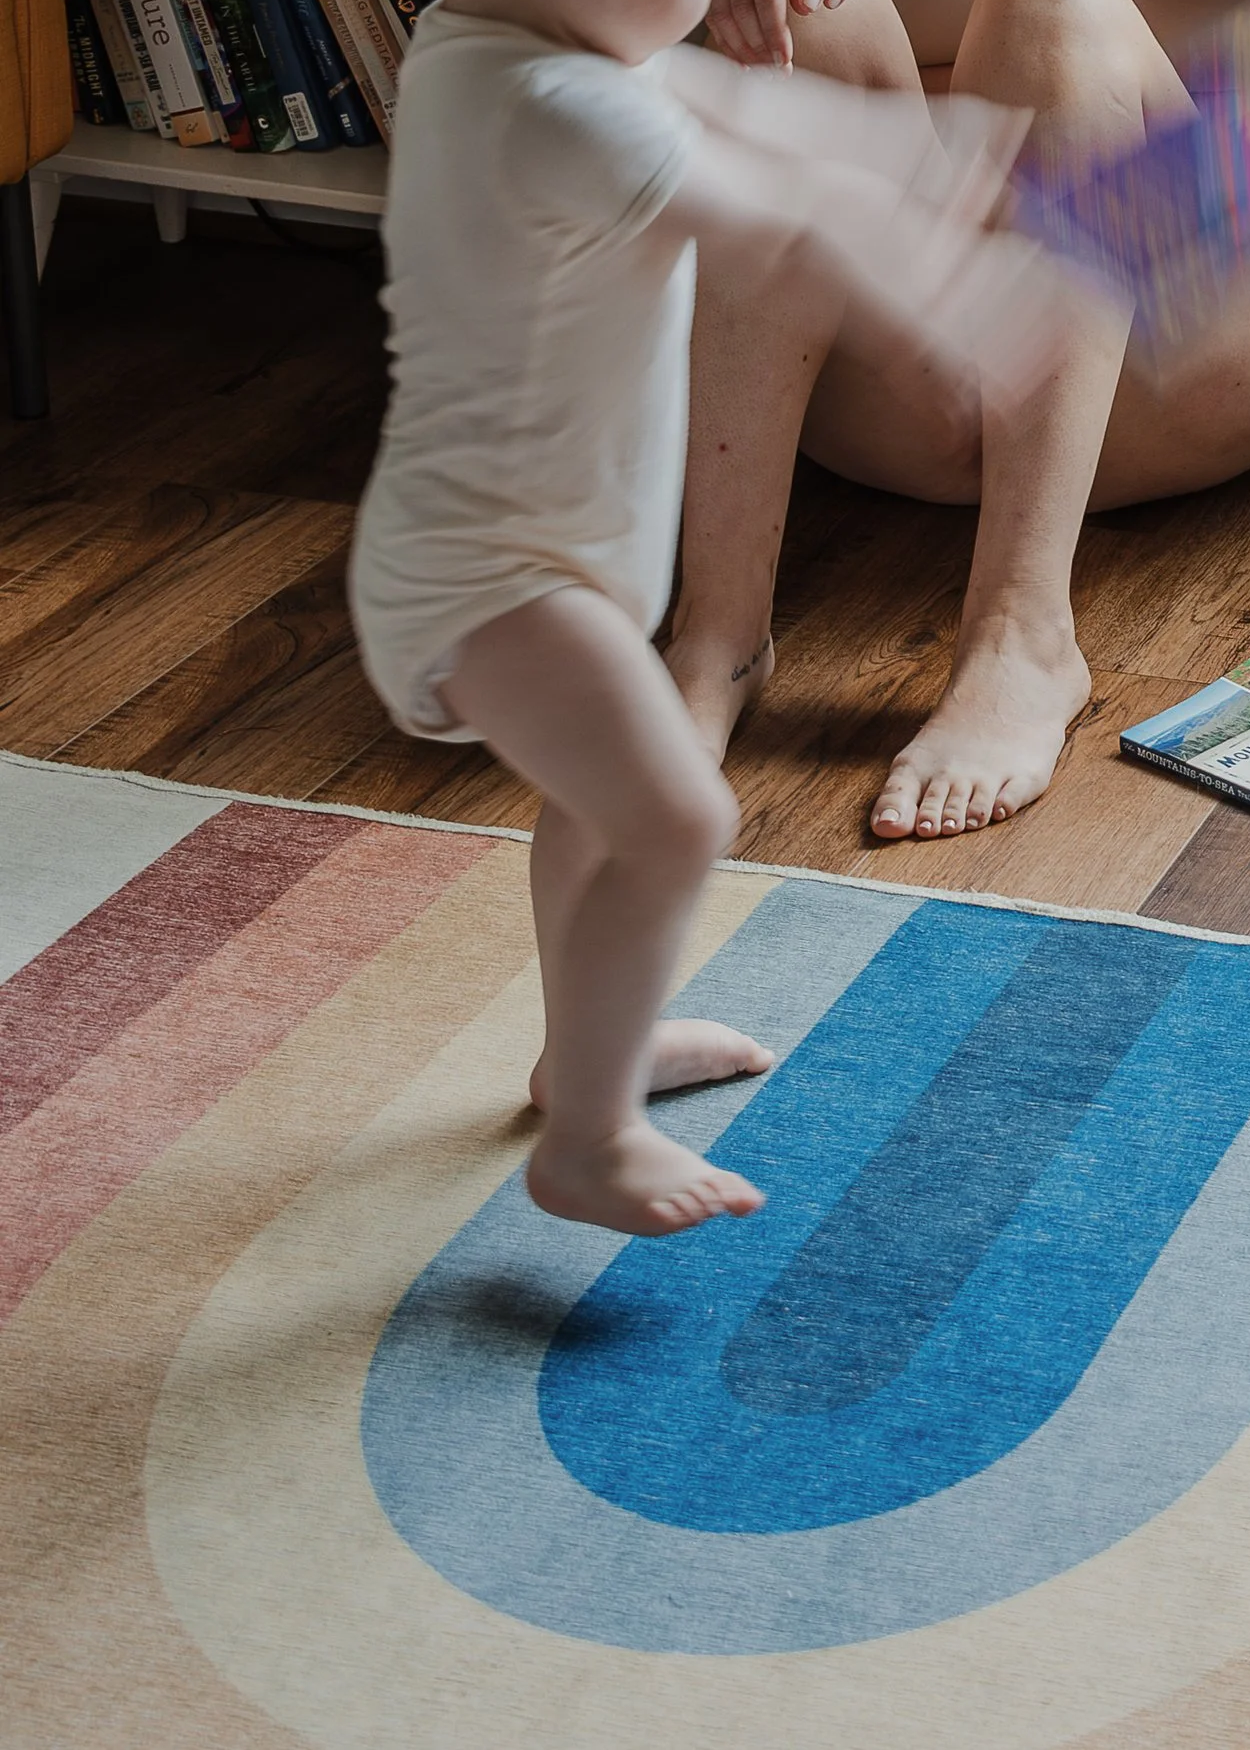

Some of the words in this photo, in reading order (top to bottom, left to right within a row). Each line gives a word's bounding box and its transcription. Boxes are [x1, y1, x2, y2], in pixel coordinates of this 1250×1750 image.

[191, 6, 212, 47] UNTAMED
[219, 3, 232, 19] IN
[225, 23, 241, 47] THE
[364, 15, 400, 87] MEDITATIO
[79, 36, 103, 98] MIDNIGHT
[144, 69, 161, 93] TRAIL
[234, 50, 259, 95] EARTH
[1137, 748, 1235, 797] MOUNTAINS-TO-SEA
